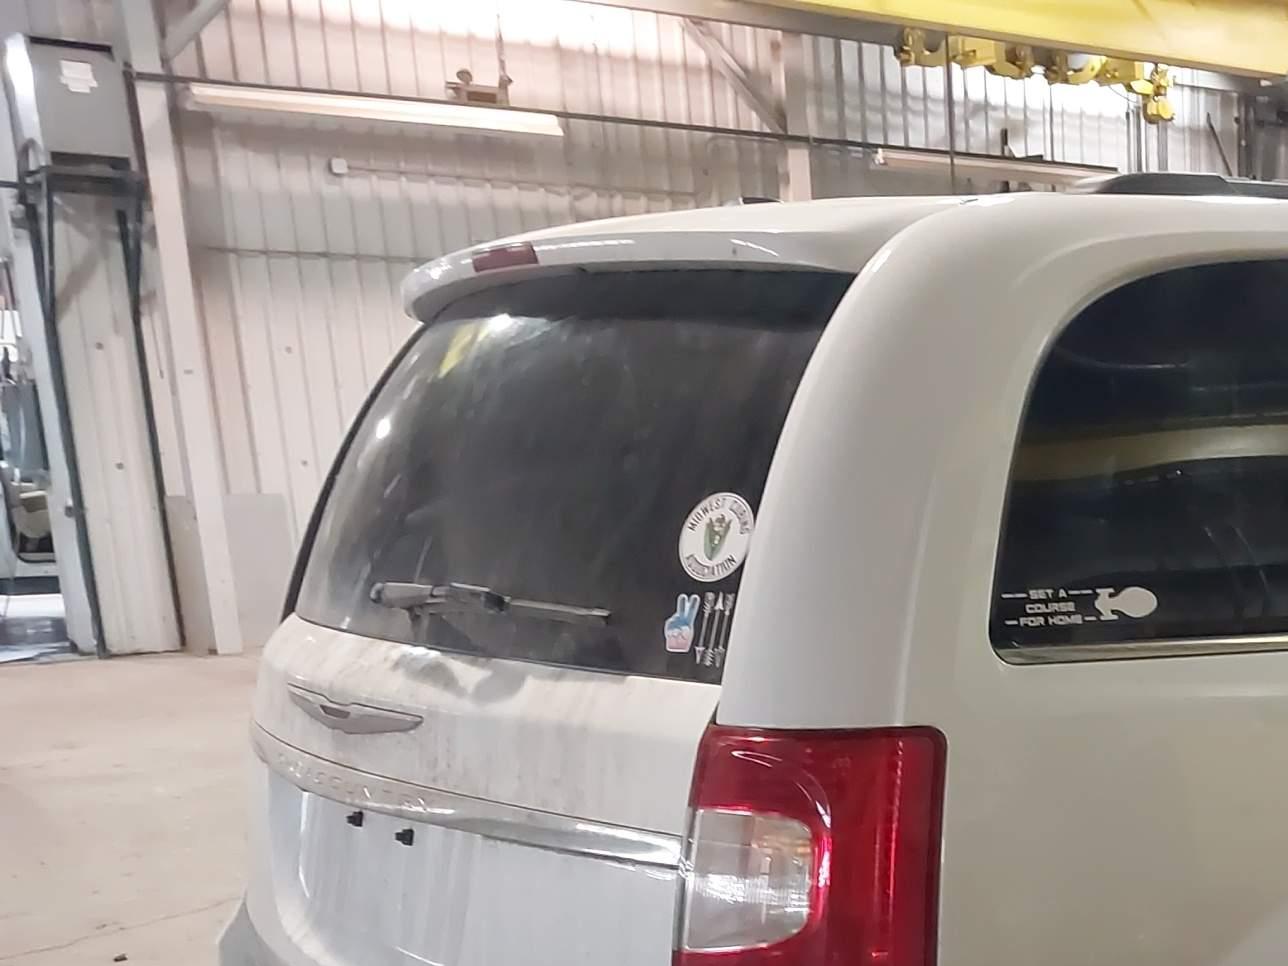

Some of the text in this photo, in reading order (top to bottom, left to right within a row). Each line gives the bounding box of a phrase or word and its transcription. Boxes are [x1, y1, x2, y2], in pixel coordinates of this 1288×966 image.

[687, 498, 726, 532] MIDWEST
[1029, 589, 1068, 600] SET A
[1025, 601, 1076, 614] COURSE
[1019, 614, 1083, 627] FOR HOME
